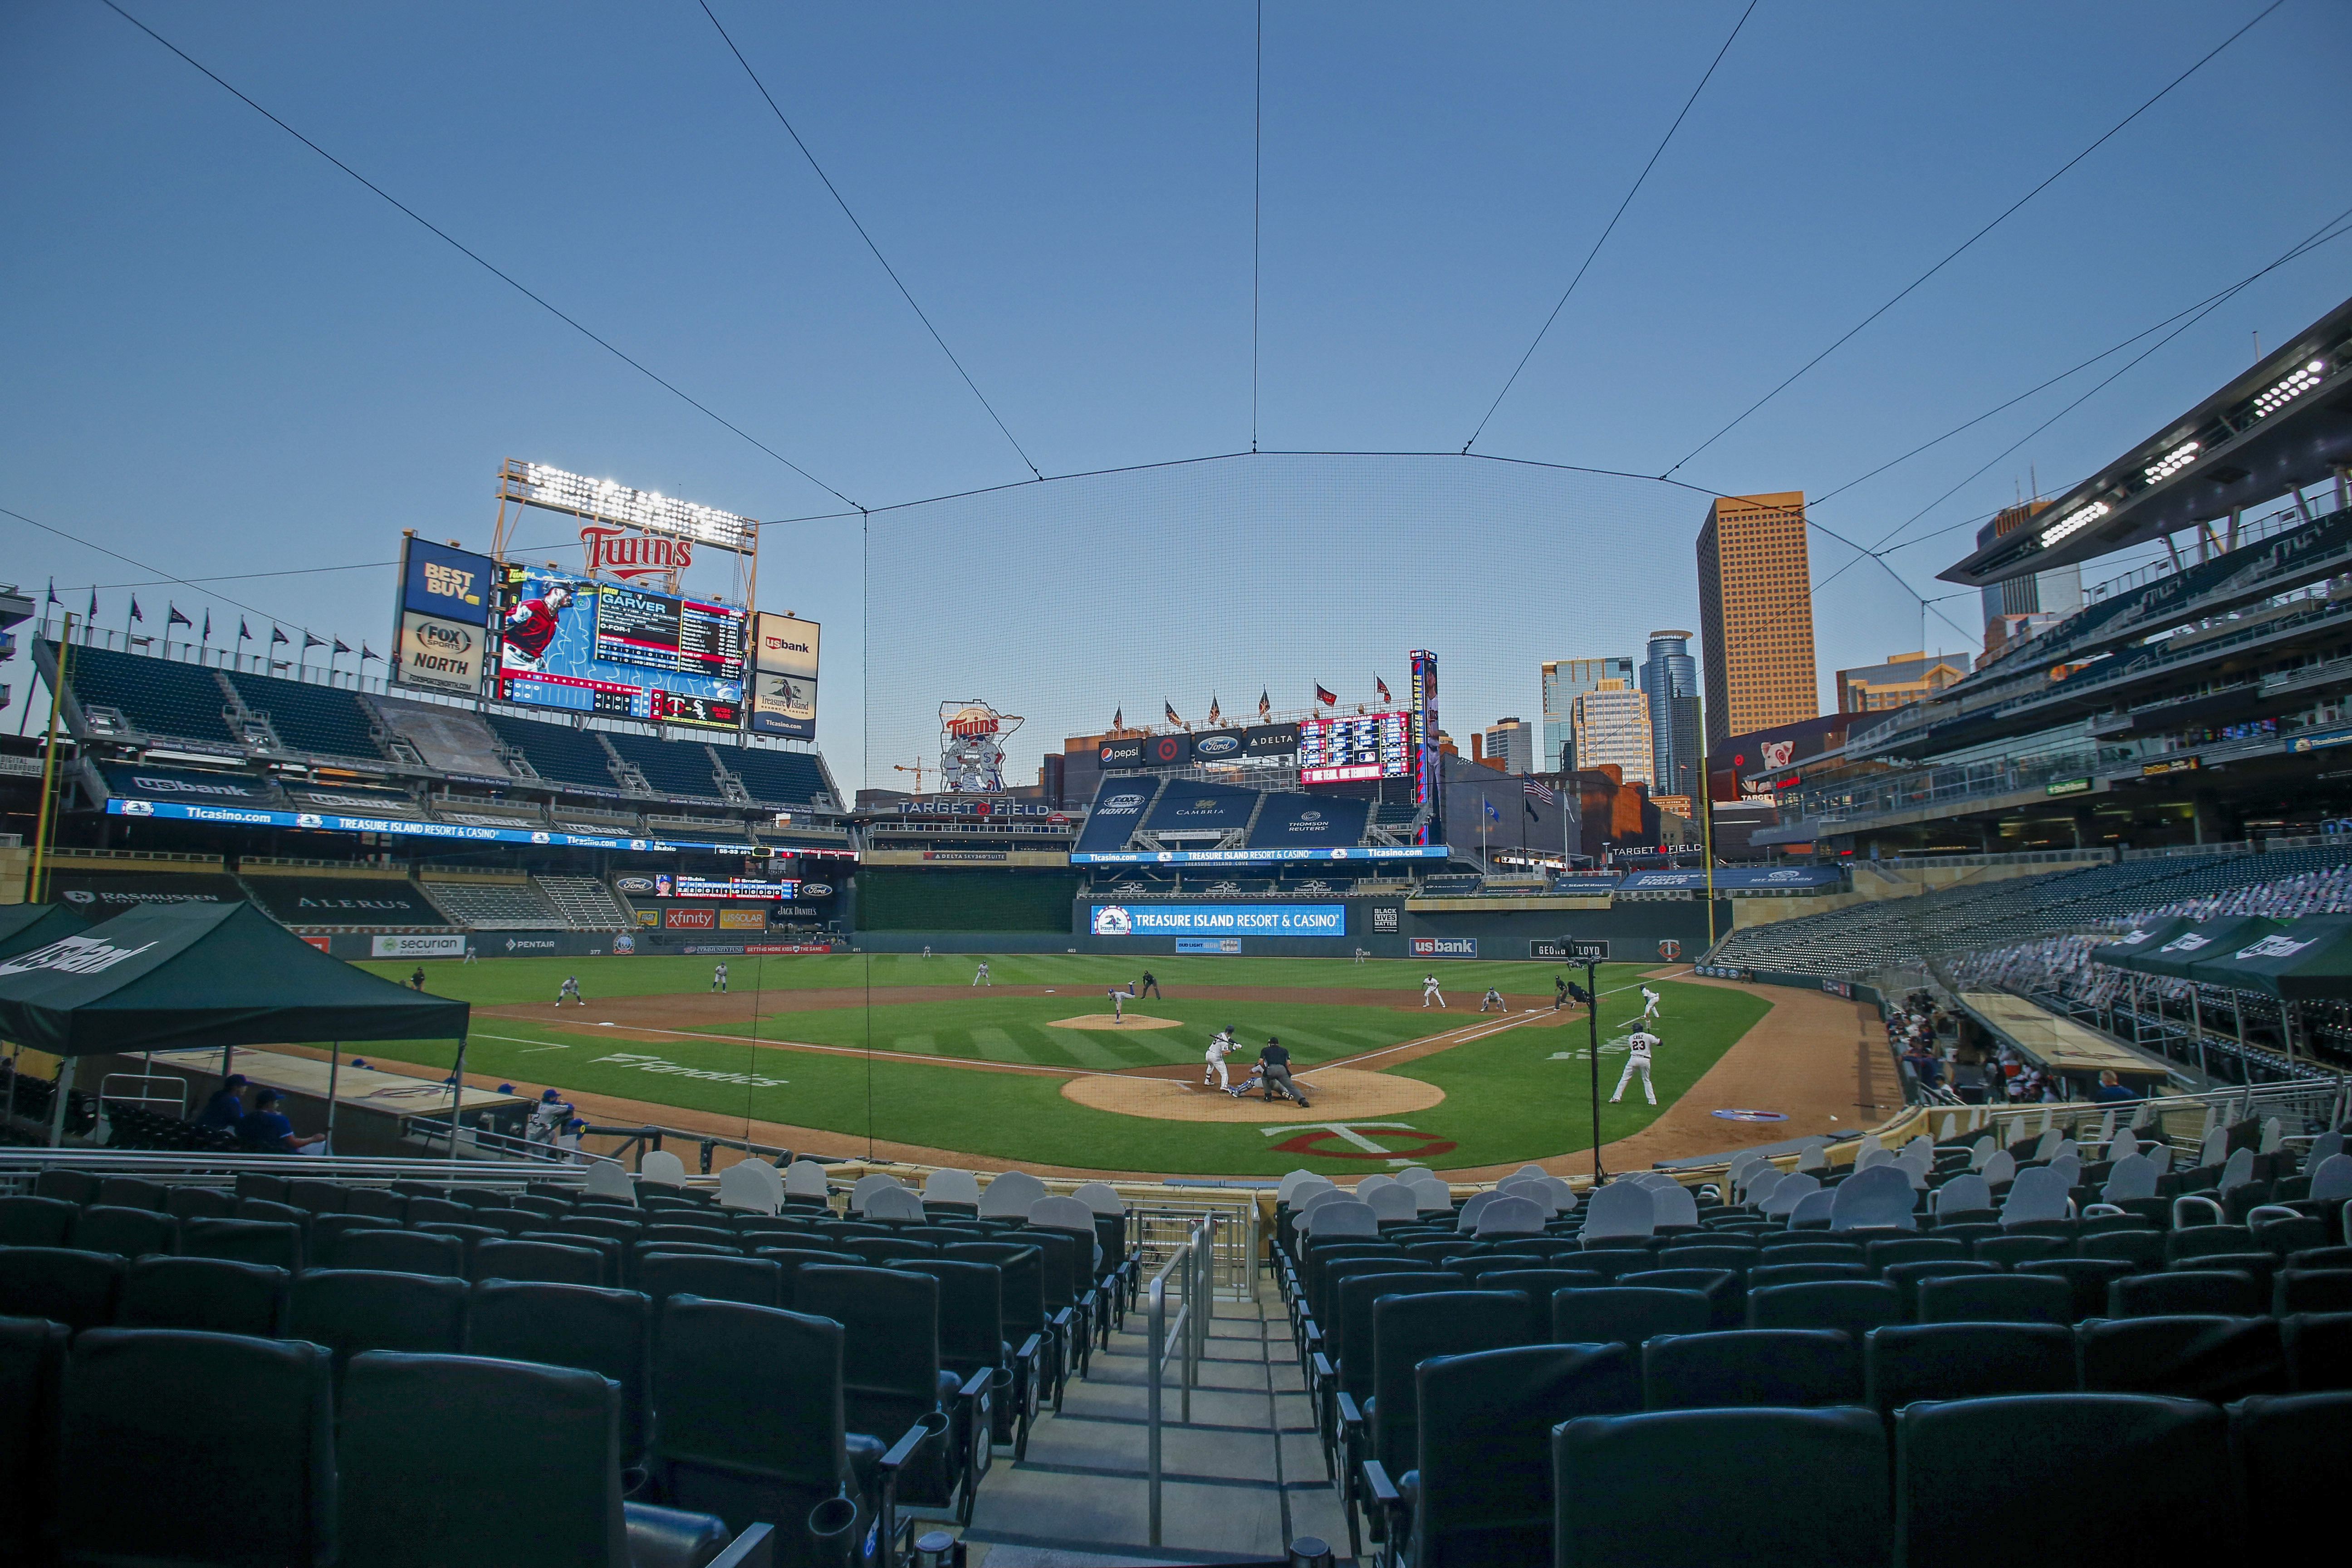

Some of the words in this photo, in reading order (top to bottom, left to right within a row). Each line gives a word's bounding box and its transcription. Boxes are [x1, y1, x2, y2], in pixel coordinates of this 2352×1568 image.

[579, 525, 693, 569] Twins
[424, 563, 475, 587] BEST
[427, 578, 469, 600] BUY
[603, 594, 666, 613] GARVER
[429, 625, 460, 644] FOX
[427, 639, 460, 650] SPORTS
[766, 638, 809, 653] usbank
[414, 653, 468, 675] NORTH
[409, 674, 471, 691] FOXSPORTSNORTH.COM
[1414, 675, 1422, 711] GARVER
[761, 695, 785, 708] Treasure
[791, 699, 808, 710] Island
[766, 719, 802, 730] TIcasino.com
[946, 716, 999, 740] Twins
[1415, 714, 1423, 744] MITCH
[1205, 739, 1230, 751] Ford
[1260, 735, 1293, 745] DELTA
[223, 748, 244, 756] Porch
[1114, 747, 1139, 760] pepsi
[0, 763, 41, 772] CLUBHOUSE
[134, 777, 253, 797] usbank
[186, 807, 271, 823] TIcasino.com
[898, 802, 975, 814] TARGET
[995, 804, 1049, 816] FIELD
[339, 818, 389, 831] TREASURE
[391, 823, 423, 833] ISLAND
[425, 824, 456, 836] RESORT
[1188, 852, 1222, 860] TREASURE
[1224, 851, 1248, 860] ISLAND
[1250, 850, 1275, 859] RESORT
[1612, 847, 1655, 855] TARGET
[1668, 844, 1702, 853] FIELD
[623, 880, 646, 889] Ford
[808, 885, 828, 895] Ford
[100, 893, 219, 902] RASMUSSEN
[299, 897, 410, 909] ALERUS
[778, 906, 793, 915] JACK
[794, 907, 816, 915] DANIEL'S
[669, 911, 711, 926] xfinity
[1136, 915, 1191, 927] TREASURE
[1194, 915, 1234, 926] ISLAND
[1237, 915, 1278, 926] RESORT
[1282, 915, 1291, 927] &
[400, 938, 457, 949] securian
[1415, 939, 1473, 952] usbank
[1539, 946, 1565, 955] GEOG
[1576, 946, 1599, 955] LOYD
[1632, 1040, 1645, 1050] 23
[621, 1060, 789, 1086] Fanatics
